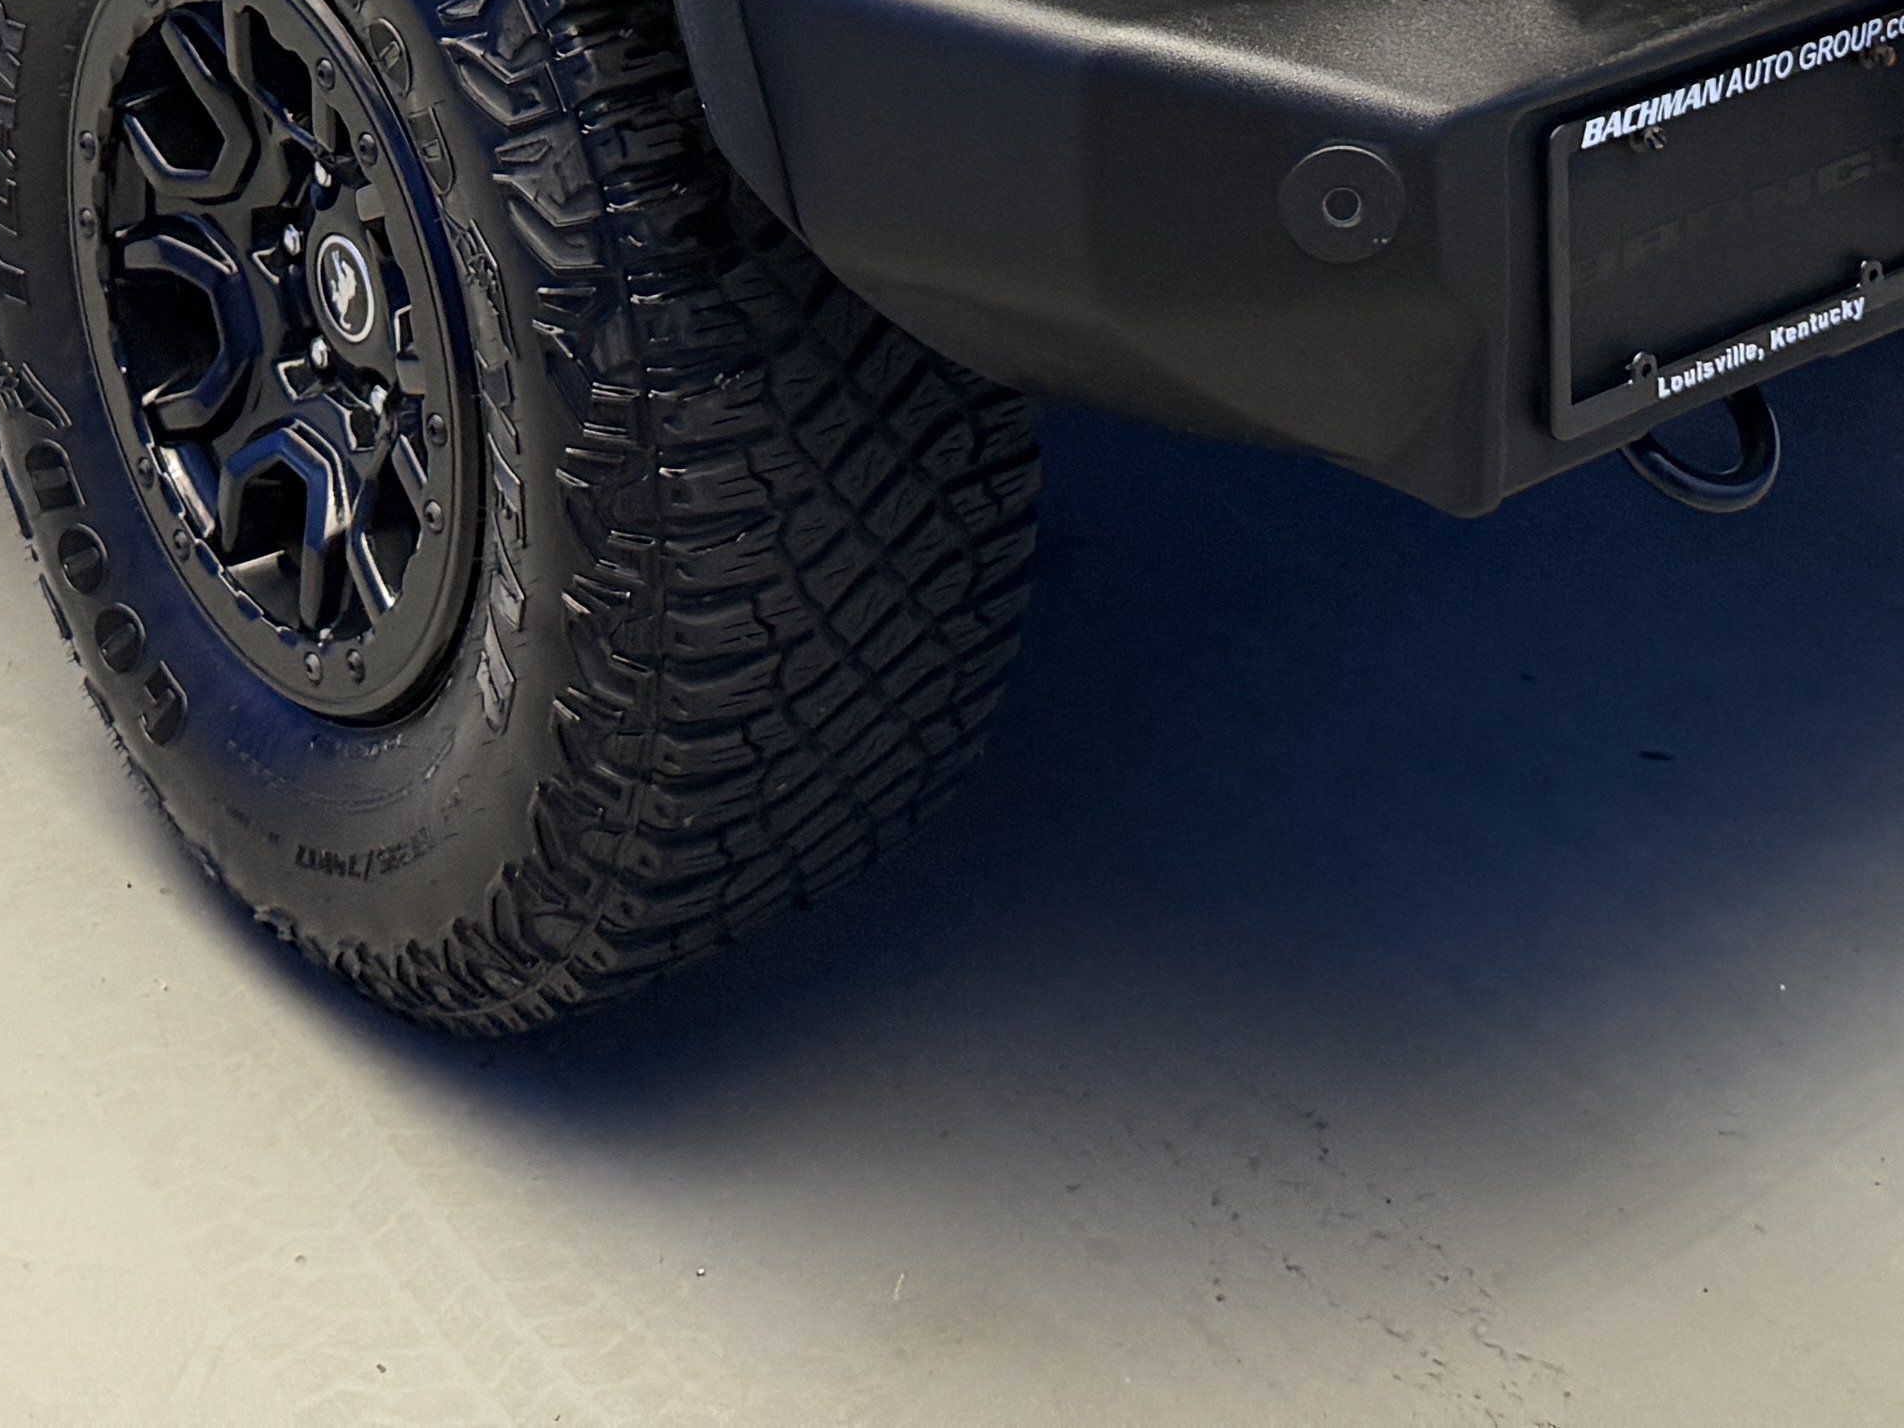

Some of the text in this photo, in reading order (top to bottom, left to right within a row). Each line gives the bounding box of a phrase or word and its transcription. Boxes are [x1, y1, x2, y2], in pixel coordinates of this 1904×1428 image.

[1581, 74, 1725, 149] BACHMAN
[1725, 50, 1794, 98] AUTO
[1657, 296, 1866, 399] Louisville, Kentucky
